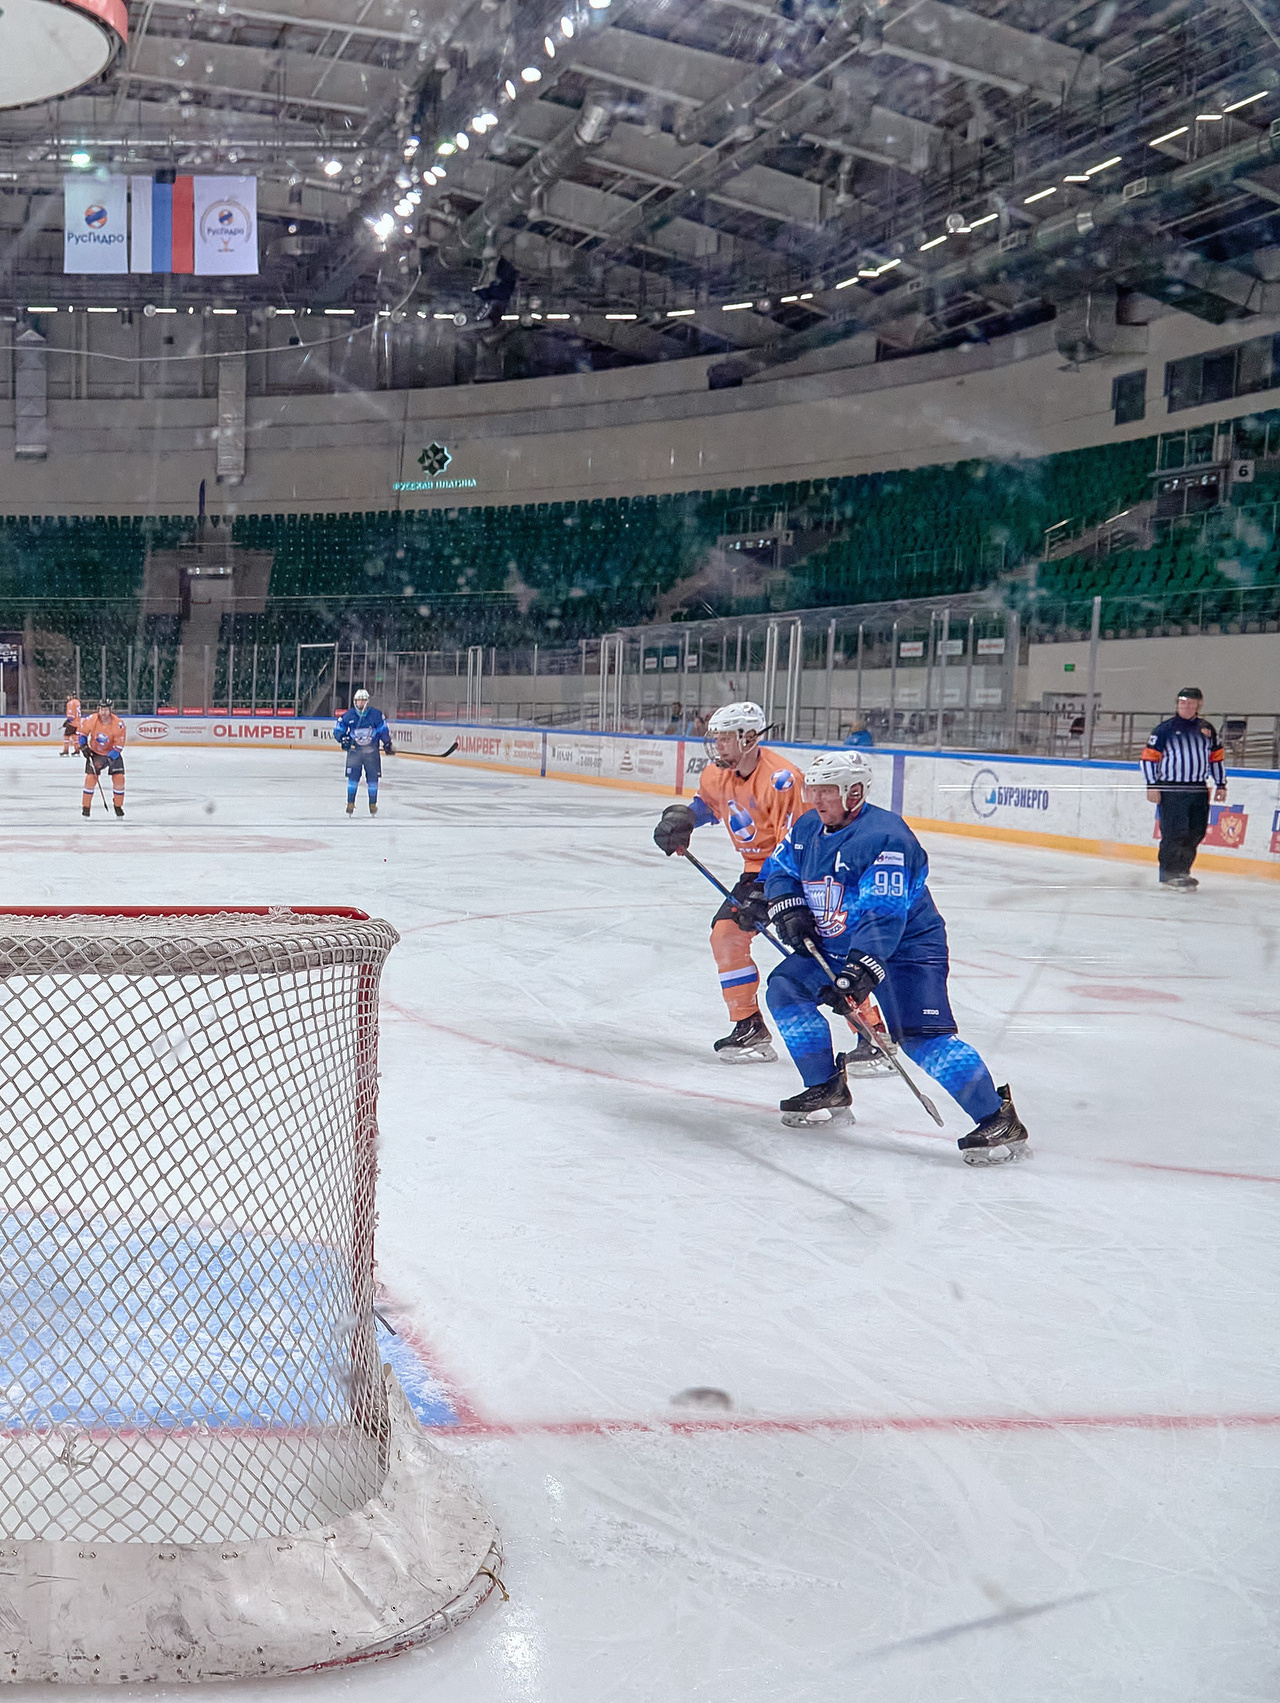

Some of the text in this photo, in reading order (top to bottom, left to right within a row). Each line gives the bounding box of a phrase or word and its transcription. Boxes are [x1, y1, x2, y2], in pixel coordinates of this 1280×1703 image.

[67, 232, 124, 246] РусГидро
[1239, 465, 1249, 477] 6
[138, 726, 168, 734] SINTEC
[213, 724, 306, 739] OLIMPBET
[997, 786, 1049, 811] БУРЭНЕРГО
[874, 871, 904, 896] 99
